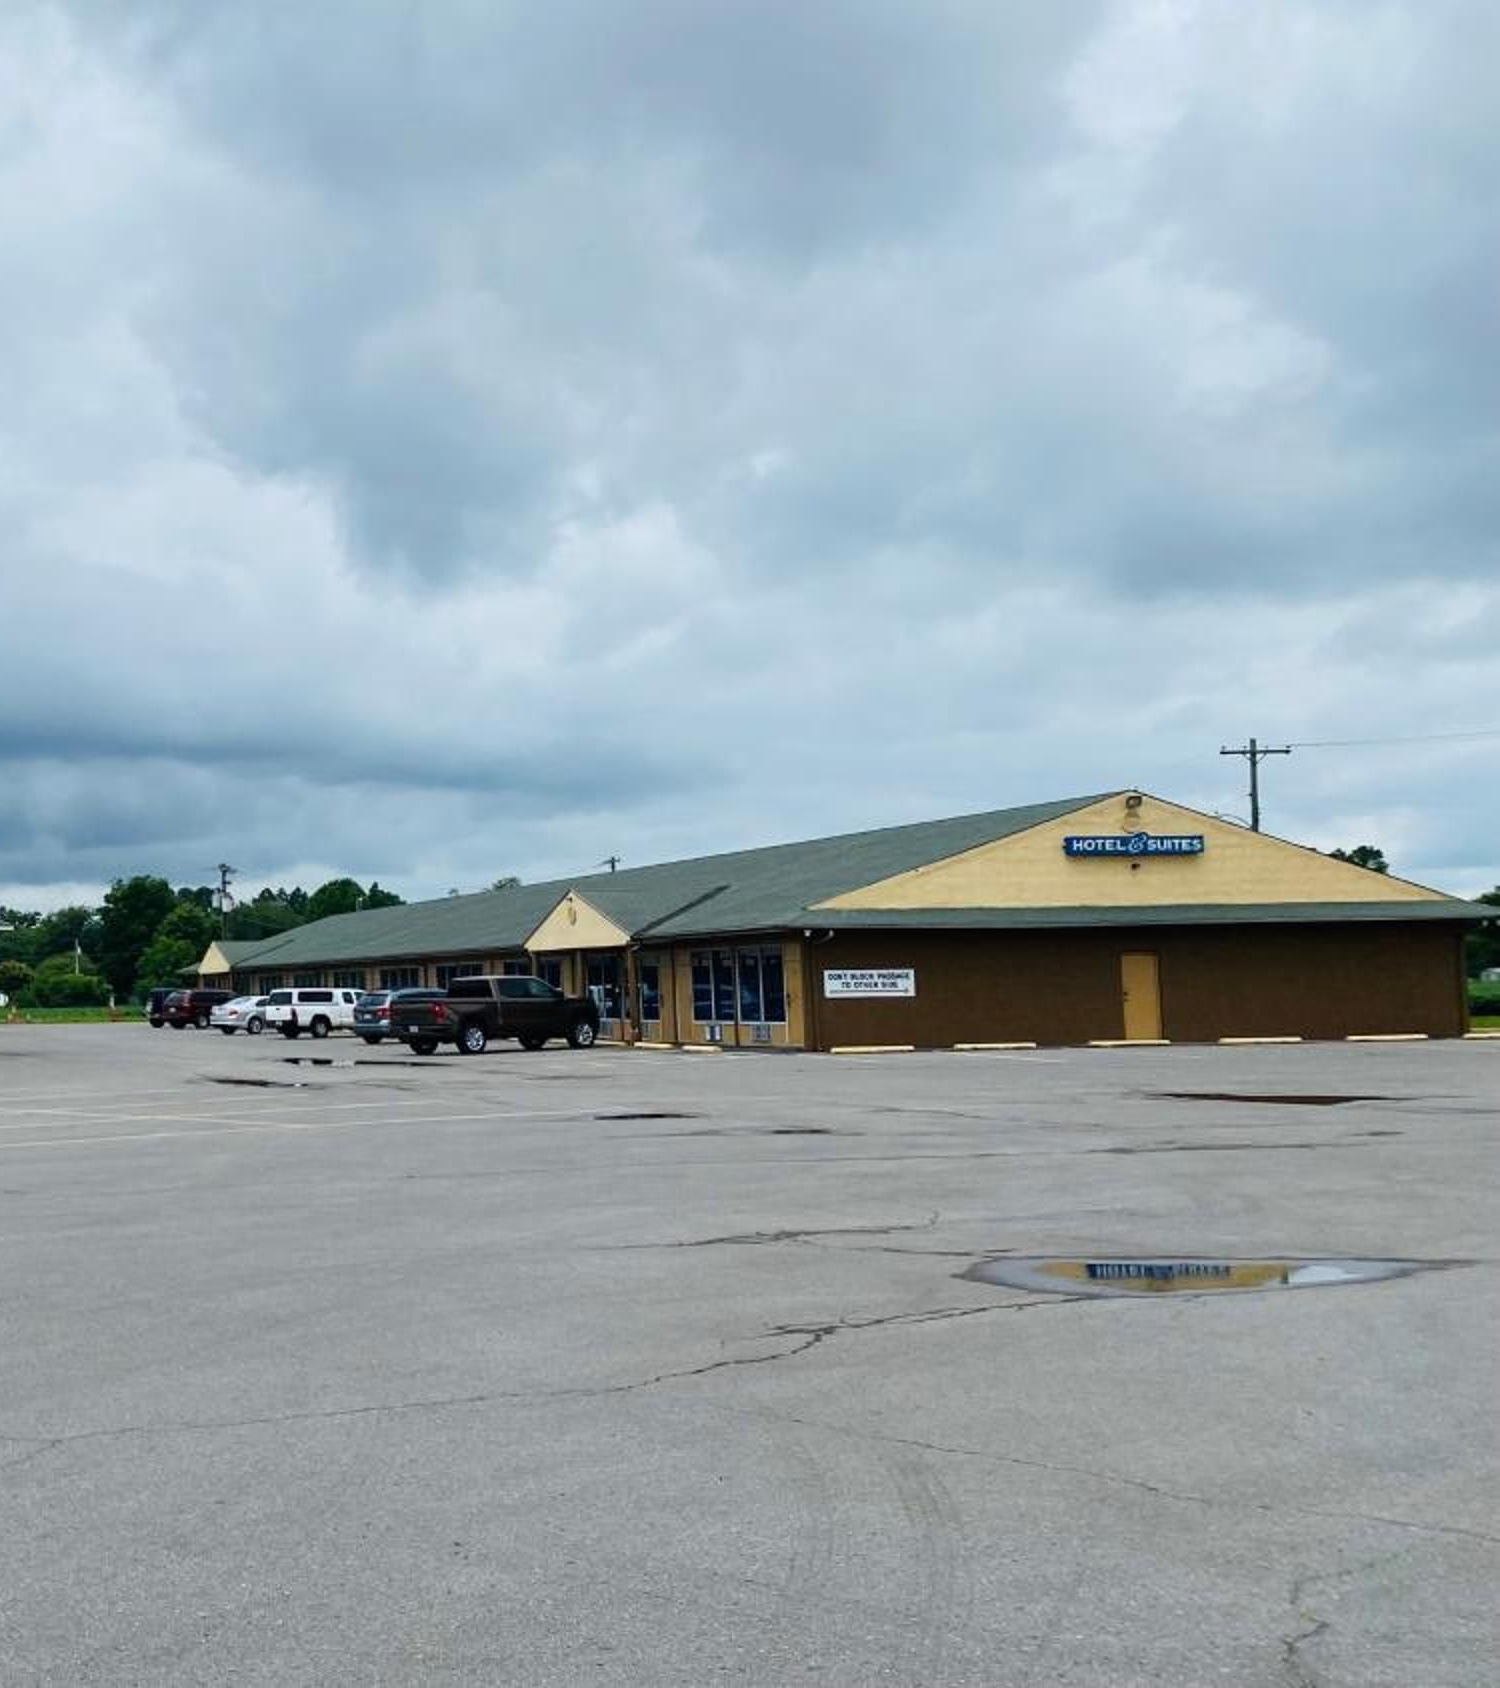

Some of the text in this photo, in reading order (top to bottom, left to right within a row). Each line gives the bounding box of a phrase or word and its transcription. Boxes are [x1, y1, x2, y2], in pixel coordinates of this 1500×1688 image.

[1072, 833, 1201, 853] HOTEL & SUITES
